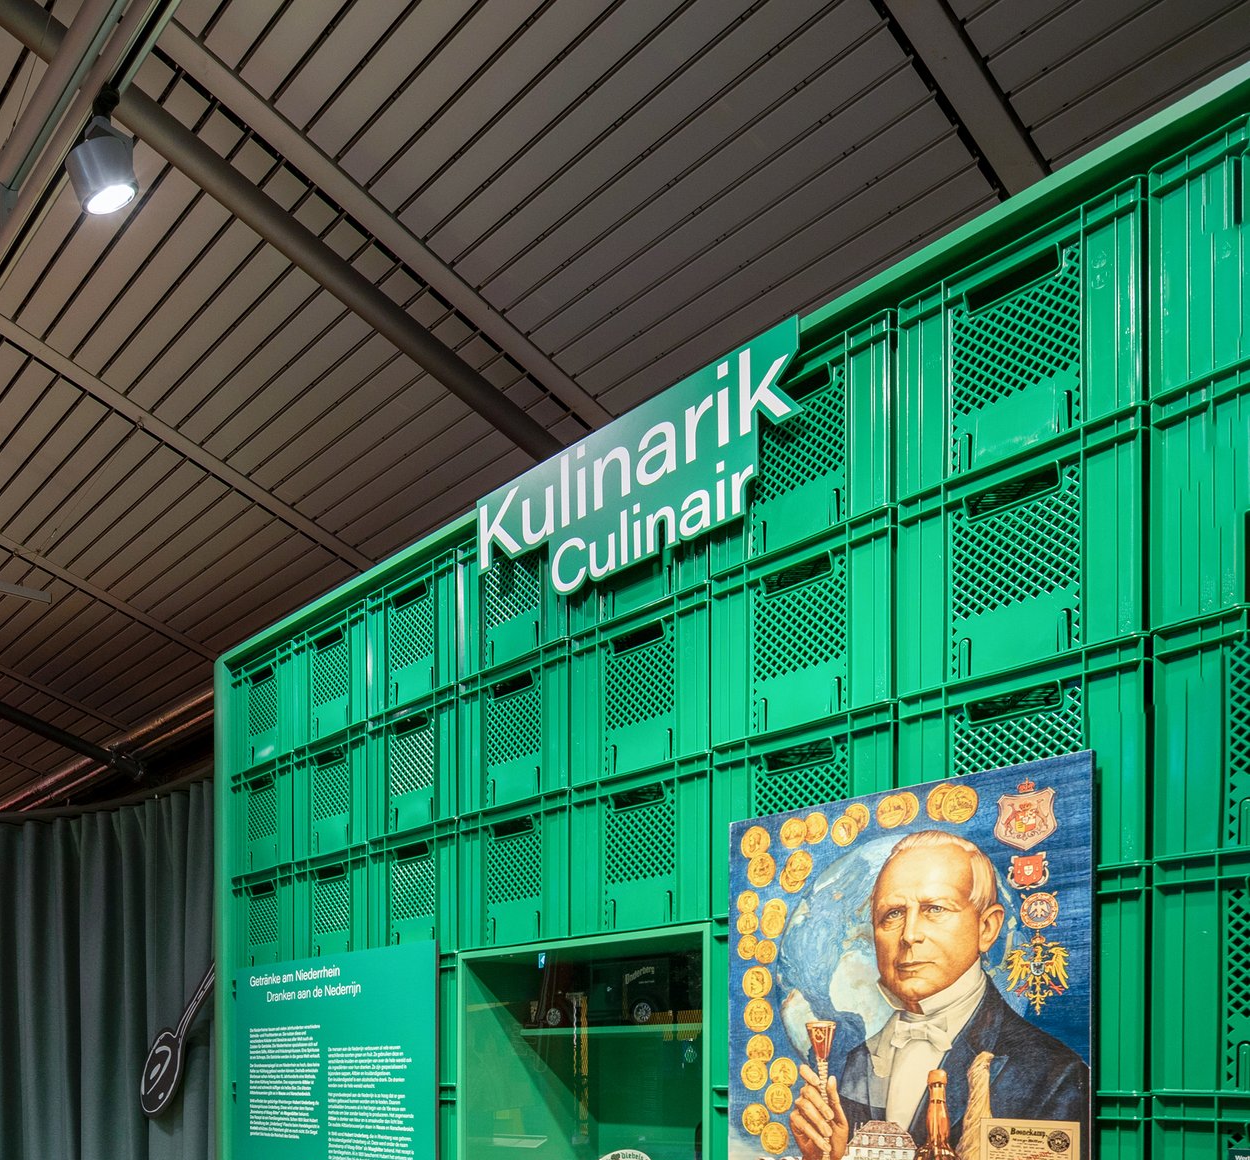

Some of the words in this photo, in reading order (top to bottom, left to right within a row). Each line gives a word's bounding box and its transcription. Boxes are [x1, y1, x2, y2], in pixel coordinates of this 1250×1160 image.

[479, 348, 792, 571] Kulinarik
[552, 460, 754, 592] Culinair
[250, 973, 281, 987] Getränke
[282, 973, 294, 983] am
[295, 964, 340, 981] Niederrhein
[266, 989, 296, 1002] Dranken
[297, 990, 311, 999] aan
[312, 985, 323, 997] de
